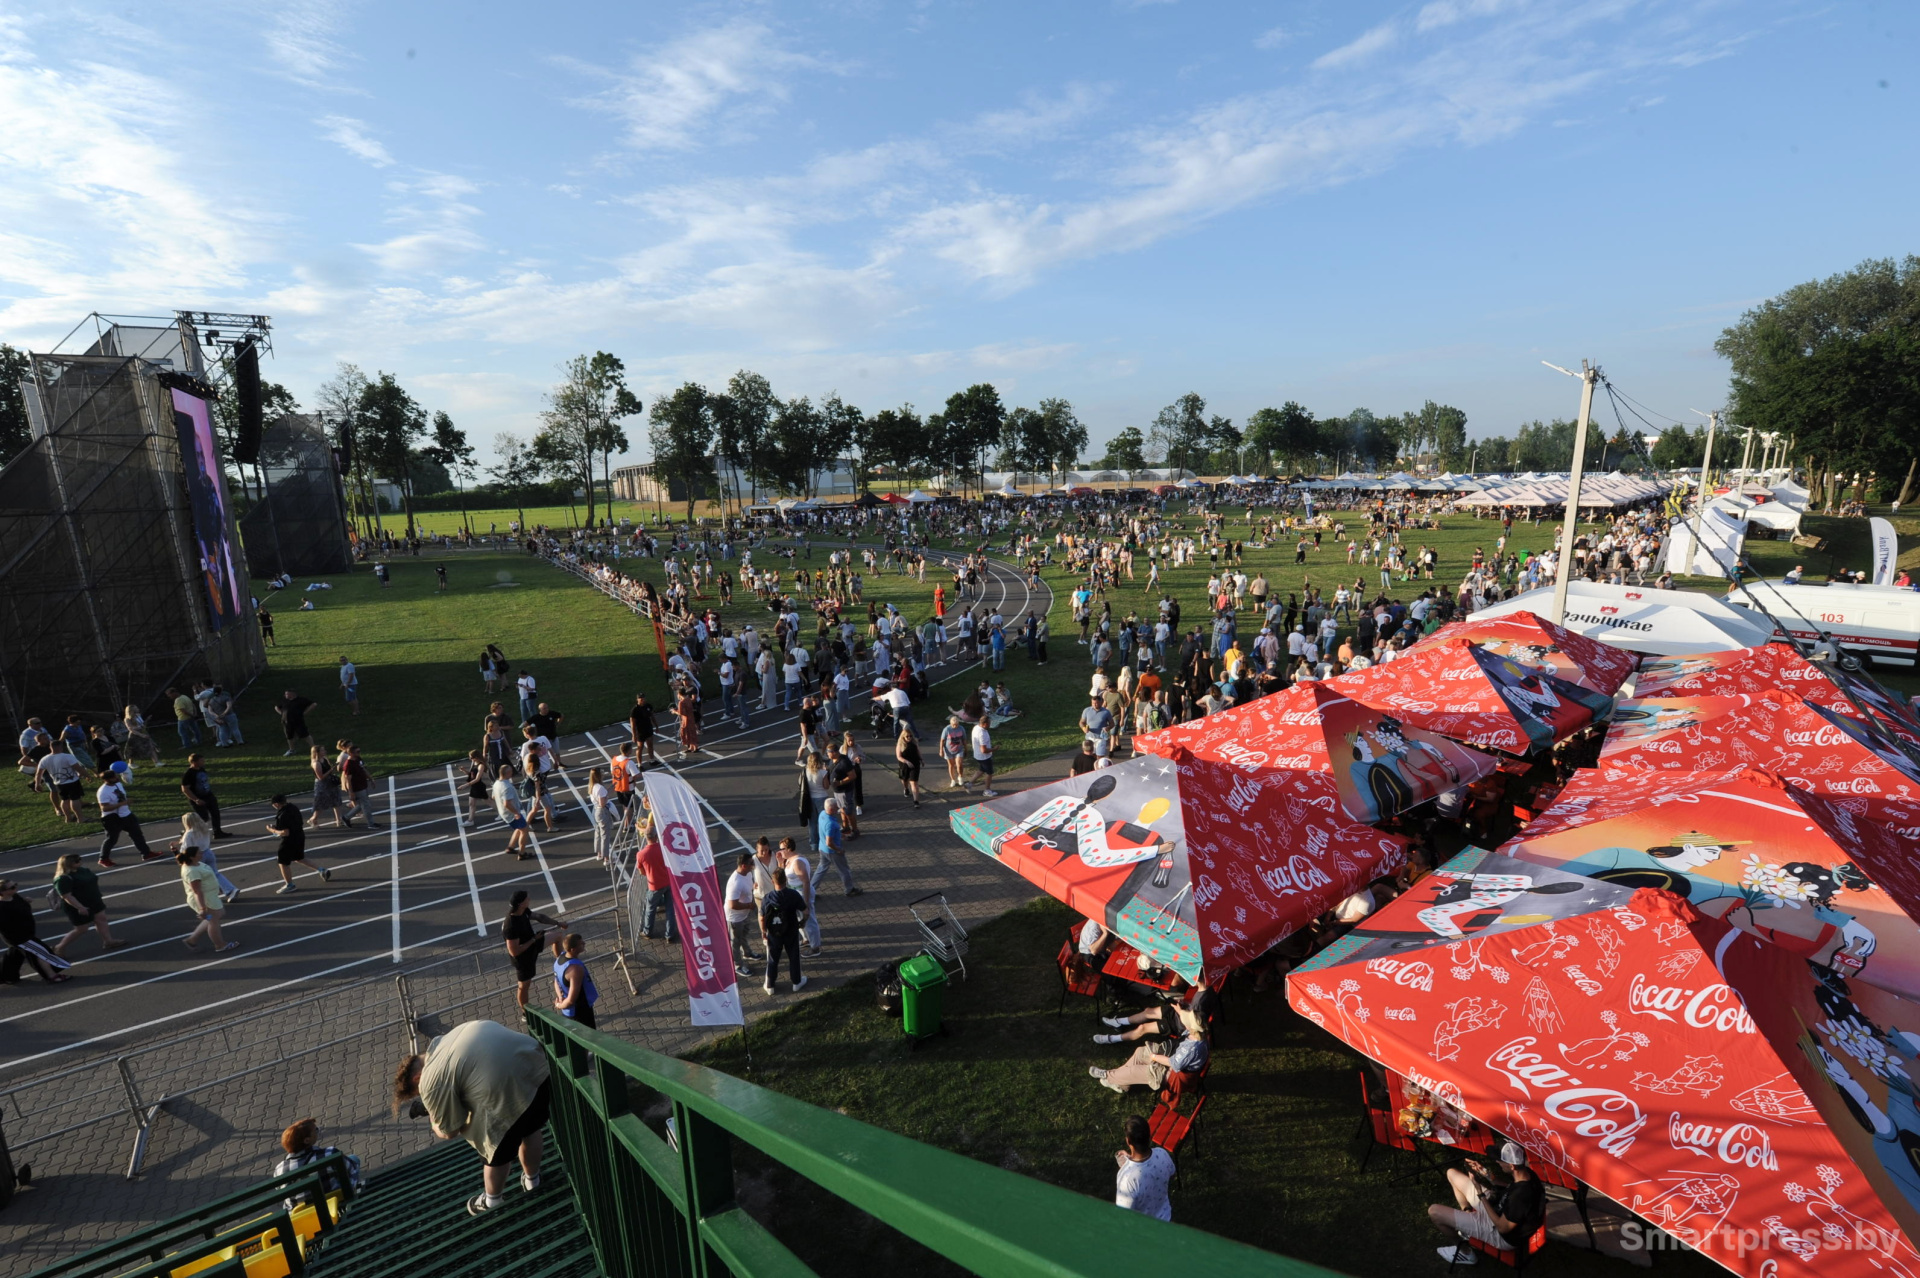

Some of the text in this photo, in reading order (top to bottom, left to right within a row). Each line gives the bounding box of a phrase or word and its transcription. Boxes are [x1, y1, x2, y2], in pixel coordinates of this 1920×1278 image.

[1820, 613, 1844, 623] 103
[1859, 638, 1892, 646] ПОМОЩЬ
[1780, 665, 1828, 681] Coca-Co
[1213, 738, 1270, 773] Coca-Cola
[1273, 753, 1312, 768] Coca-Cola
[1220, 773, 1263, 816] Coca-Cola
[1825, 777, 1882, 794] Coca-Cola
[1255, 855, 1333, 898] Coca-Cola
[1562, 964, 1604, 997] Coca-Cola
[1384, 1006, 1417, 1021] Coca-Cola
[1629, 973, 1757, 1034] Coca-Cola
[1486, 1036, 1648, 1158] Coca-Cola
[1668, 1111, 1780, 1171] Coca-Cola
[1760, 1215, 1818, 1262] Coca-Cola
